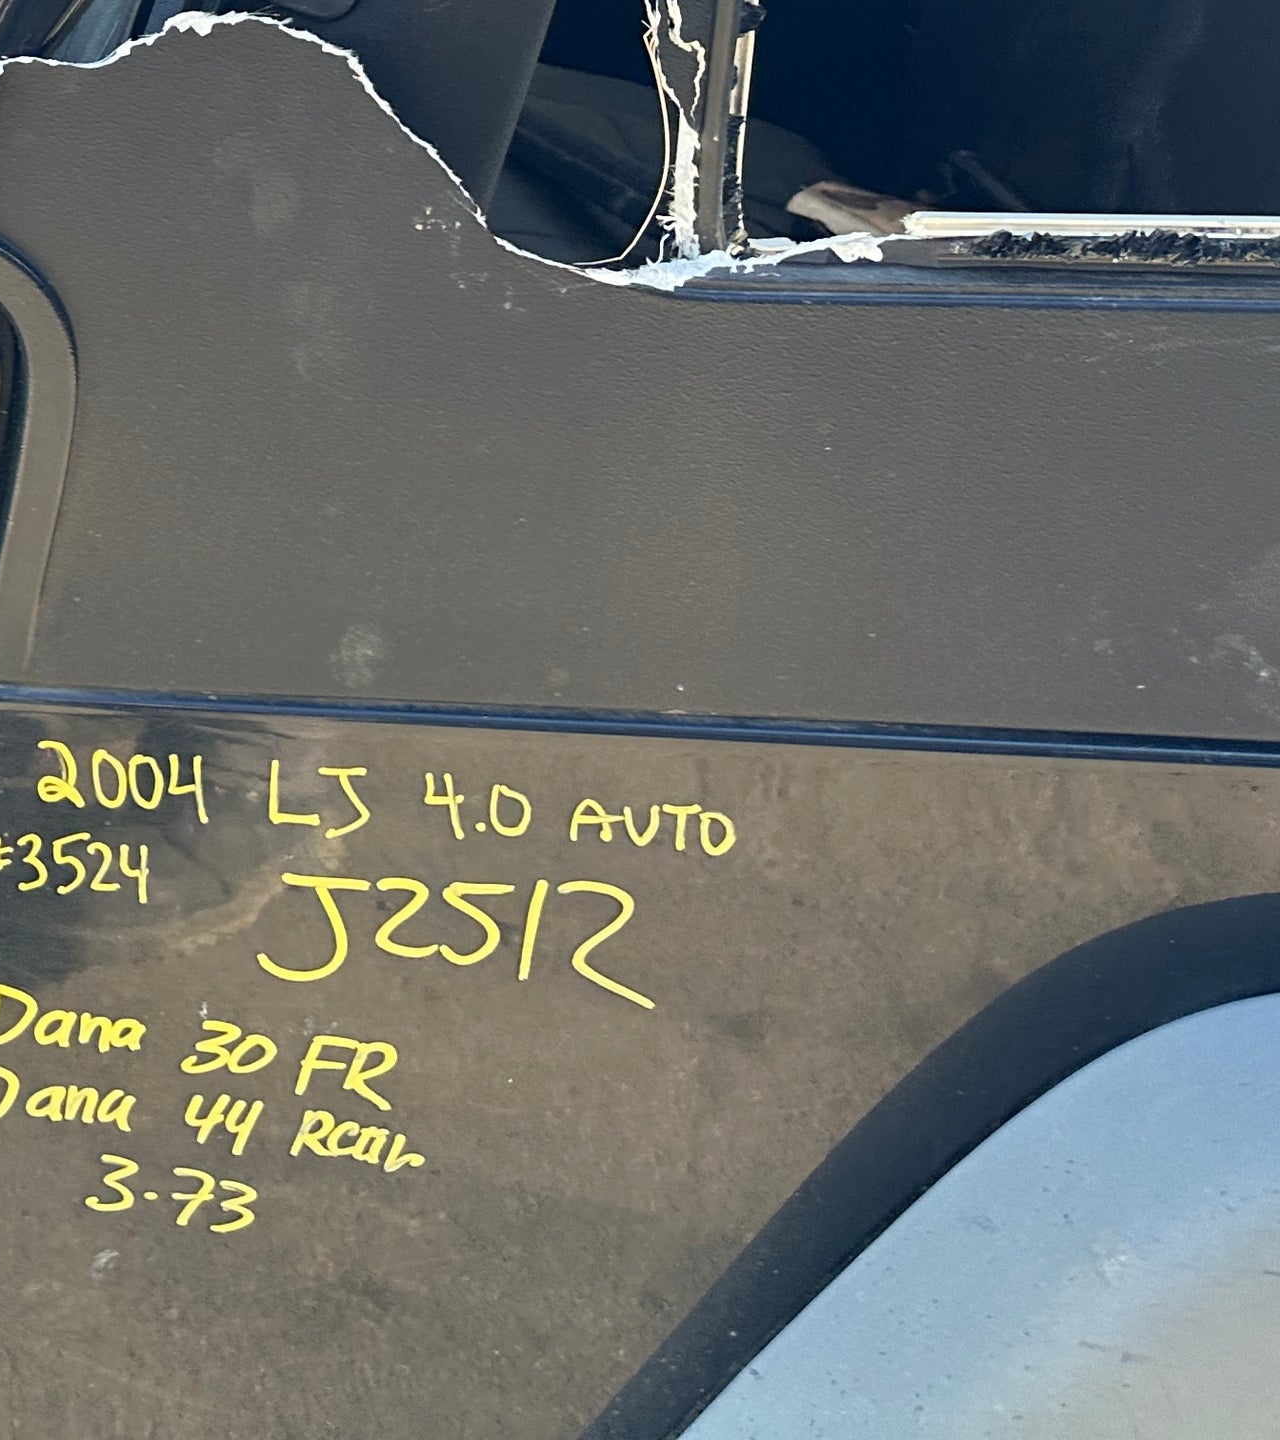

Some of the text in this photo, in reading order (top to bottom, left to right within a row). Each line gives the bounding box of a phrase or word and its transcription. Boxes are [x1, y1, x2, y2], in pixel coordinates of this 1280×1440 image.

[37, 740, 737, 858] 2004 LJ 4.0 AUTO
[256, 872, 656, 1011] J2512
[180, 1020, 276, 1075] 30
[295, 1034, 399, 1111] FR
[184, 1093, 264, 1157] 44
